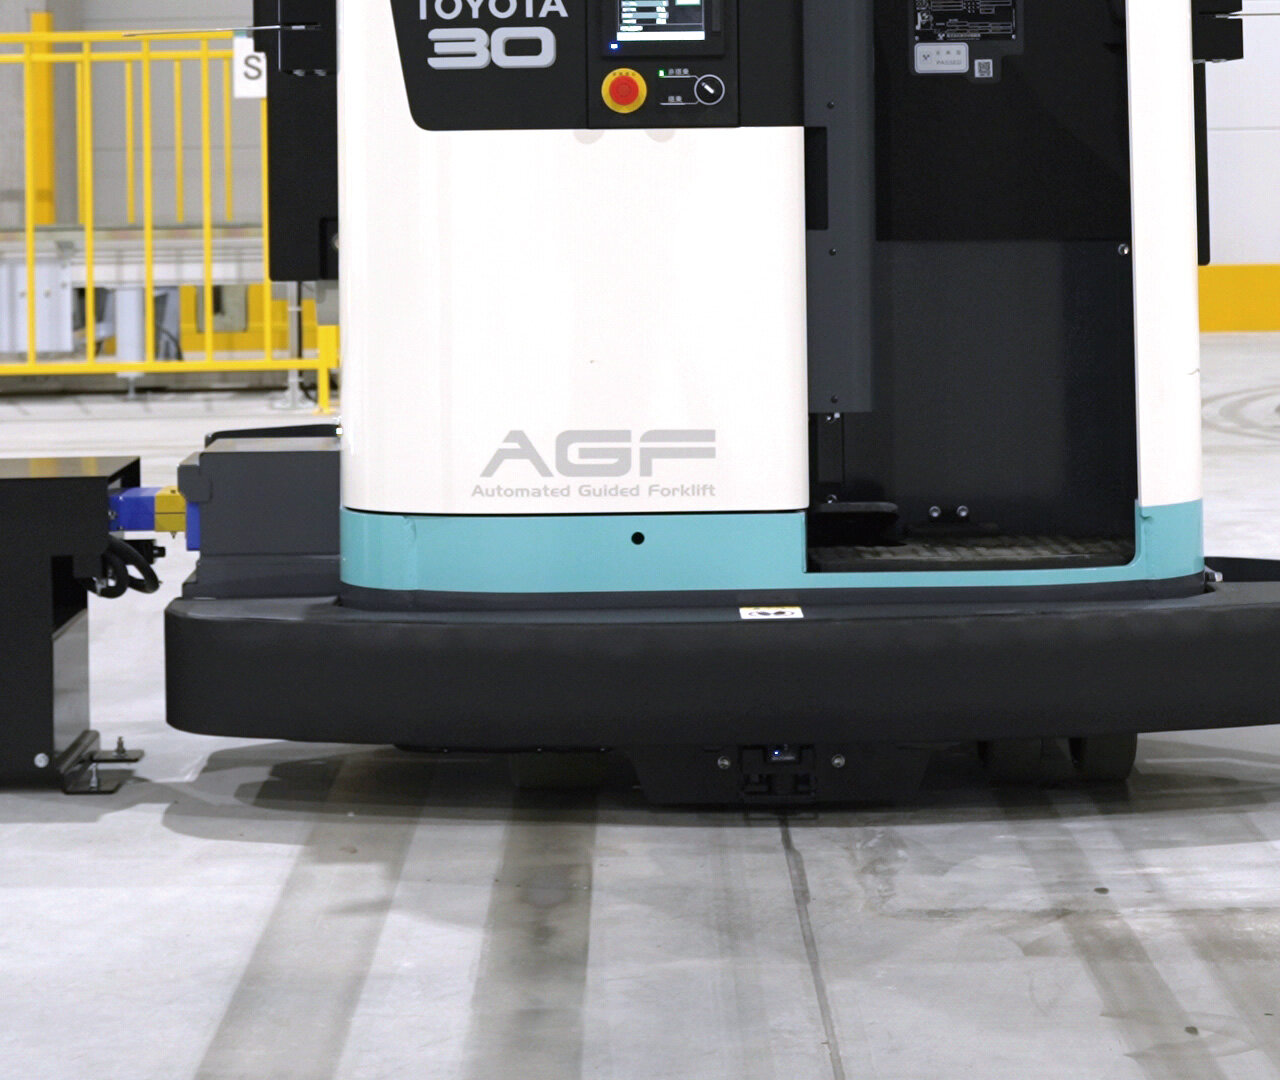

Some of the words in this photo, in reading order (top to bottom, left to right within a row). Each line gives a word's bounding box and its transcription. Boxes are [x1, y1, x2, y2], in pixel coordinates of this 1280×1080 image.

[427, 27, 556, 69] 30
[243, 55, 262, 80] S
[480, 430, 716, 477] AGF
[471, 484, 571, 498] Automated
[578, 484, 640, 498] Guided
[648, 484, 716, 497] Forklift
